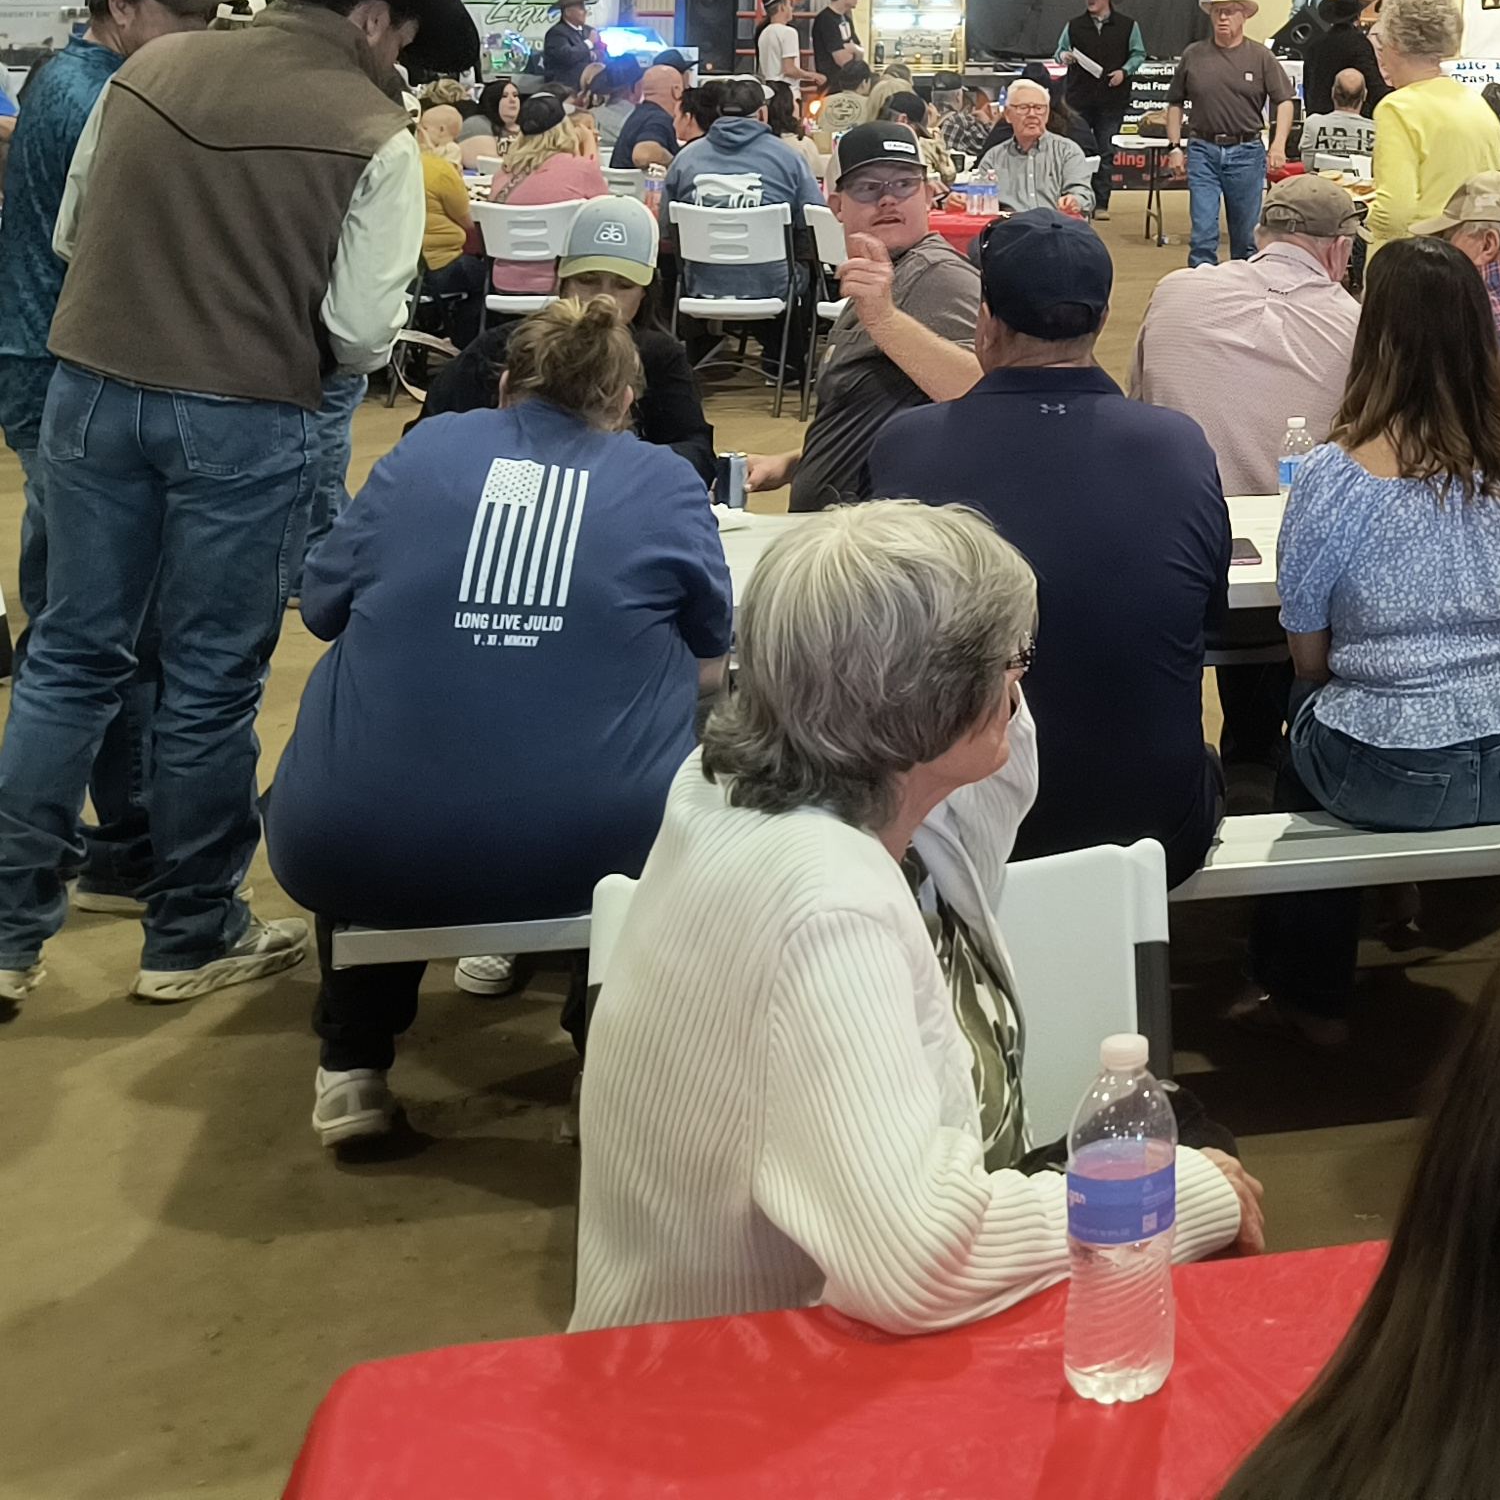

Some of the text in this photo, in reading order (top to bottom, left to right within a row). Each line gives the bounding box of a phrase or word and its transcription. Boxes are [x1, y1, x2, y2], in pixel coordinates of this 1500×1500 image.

[1451, 73, 1495, 83] Trash
[454, 611, 564, 632] LONG LIVE JULIO
